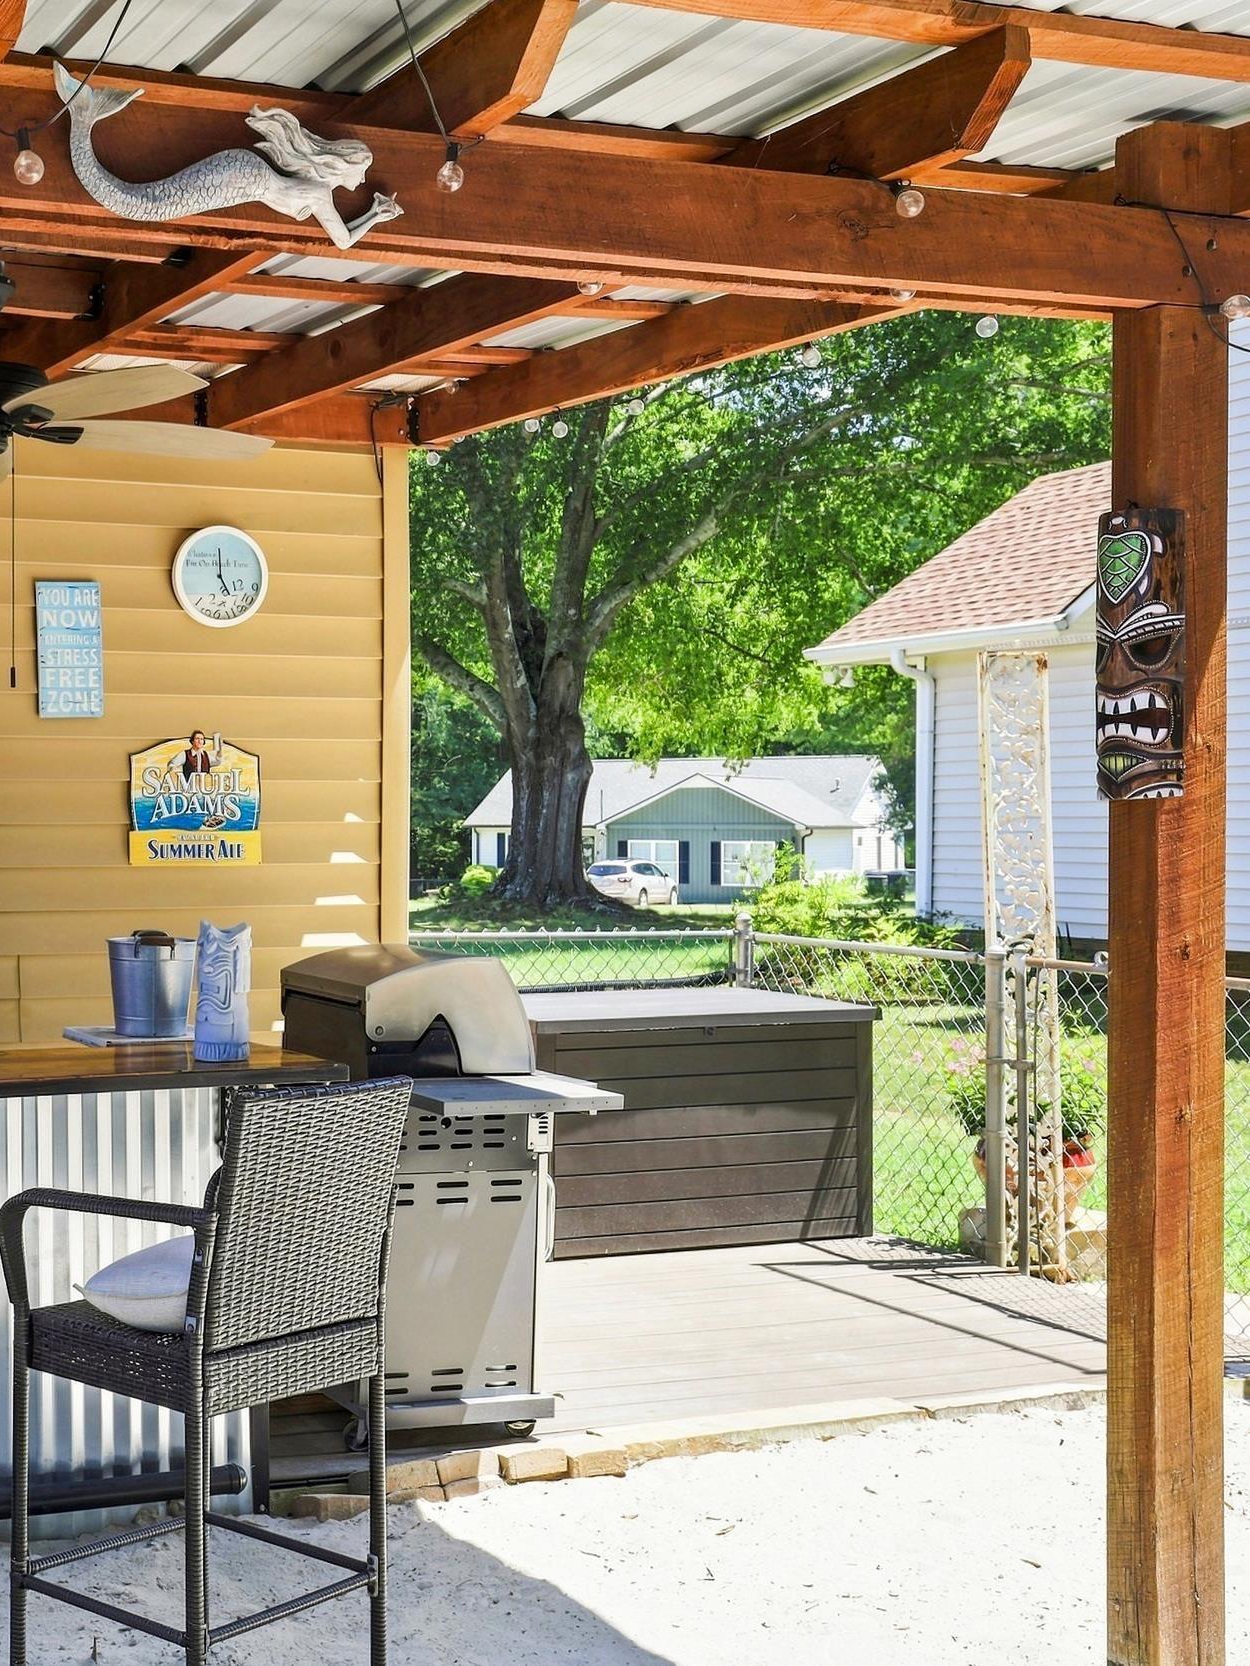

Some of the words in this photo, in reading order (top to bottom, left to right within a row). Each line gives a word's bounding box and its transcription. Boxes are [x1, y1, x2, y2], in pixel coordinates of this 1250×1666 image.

[231, 579, 244, 591] 12
[251, 582, 259, 592] 9
[38, 588, 70, 607] YOU
[73, 588, 99, 607] ARE
[42, 609, 99, 627] NOW
[45, 648, 99, 666] STRESS
[45, 668, 100, 688] FREE
[46, 691, 100, 713] ZONE
[142, 767, 251, 798] SAMUEL
[150, 794, 242, 823] ADAMS
[148, 839, 217, 862] SUMMER
[218, 839, 244, 860] ALE
